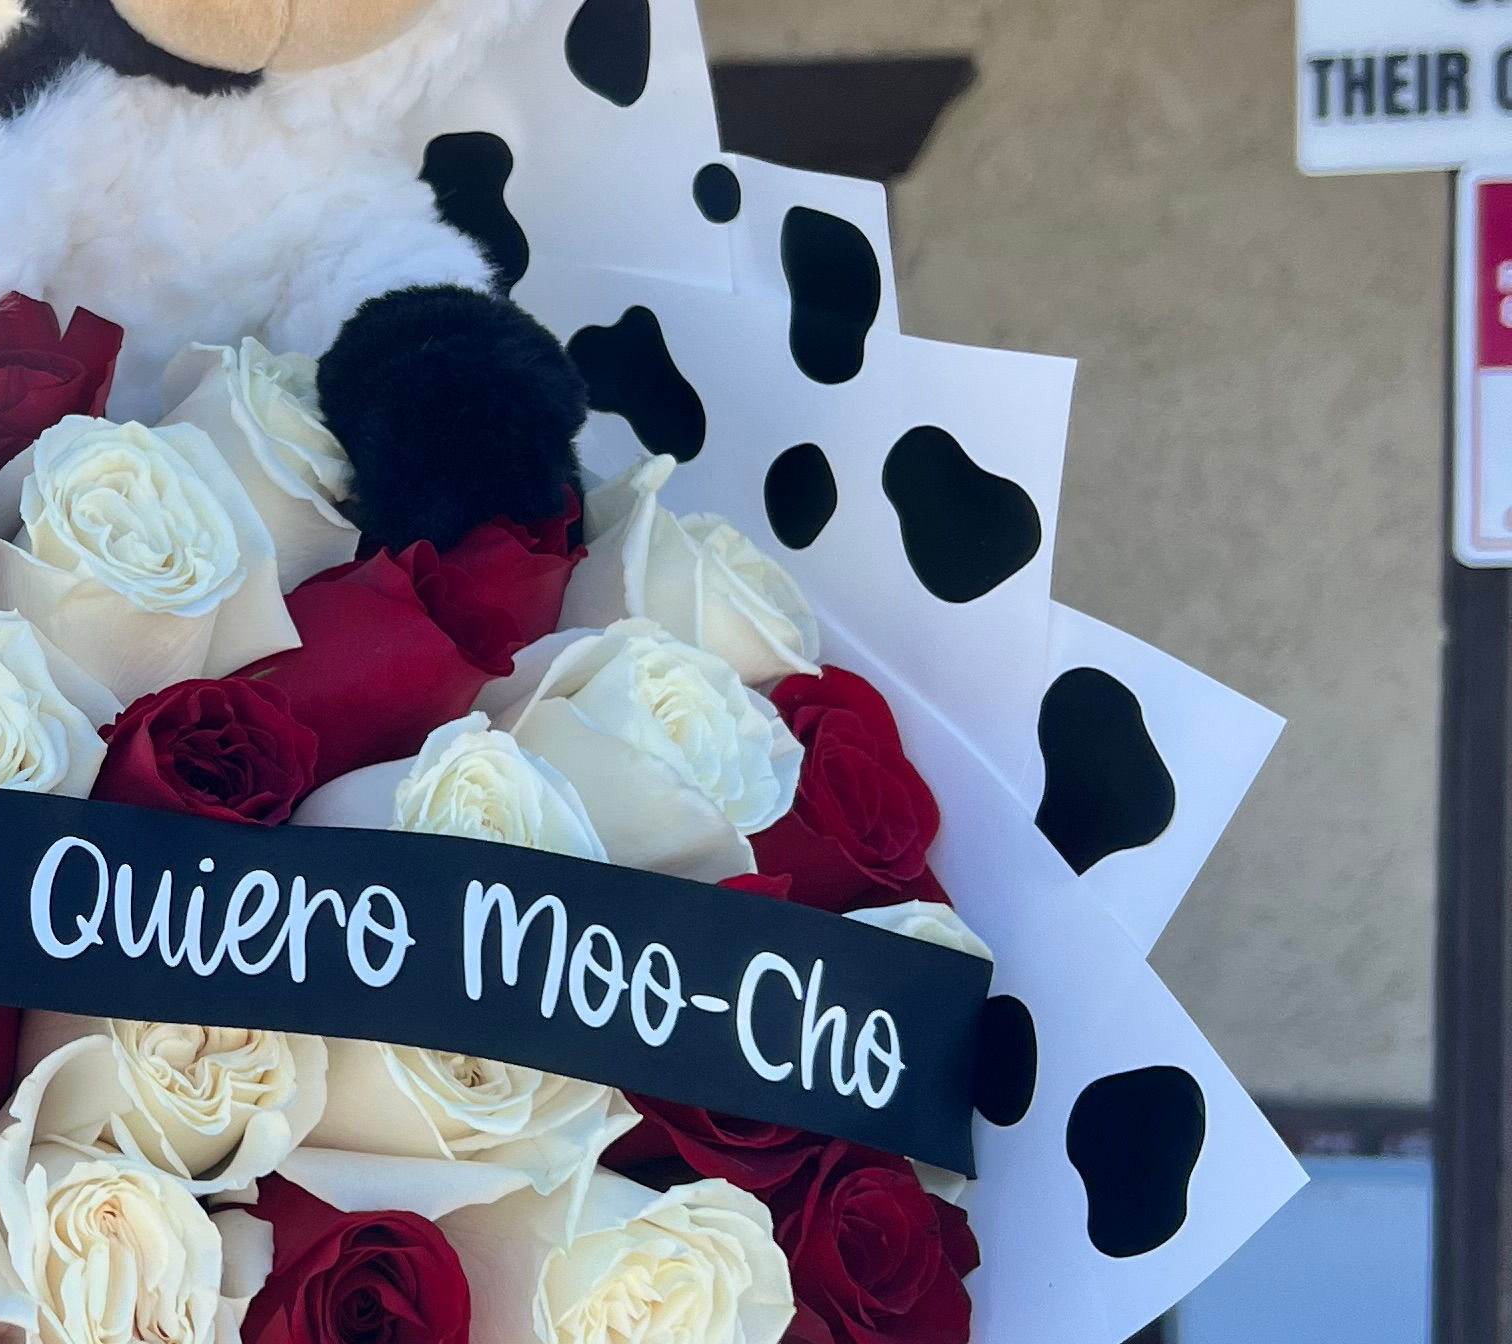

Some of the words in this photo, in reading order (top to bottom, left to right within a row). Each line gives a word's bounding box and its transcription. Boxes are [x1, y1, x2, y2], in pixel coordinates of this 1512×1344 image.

[1308, 52, 1470, 119] THEIR
[29, 835, 415, 988] Quiero
[462, 878, 908, 1110] Moo-Cho
